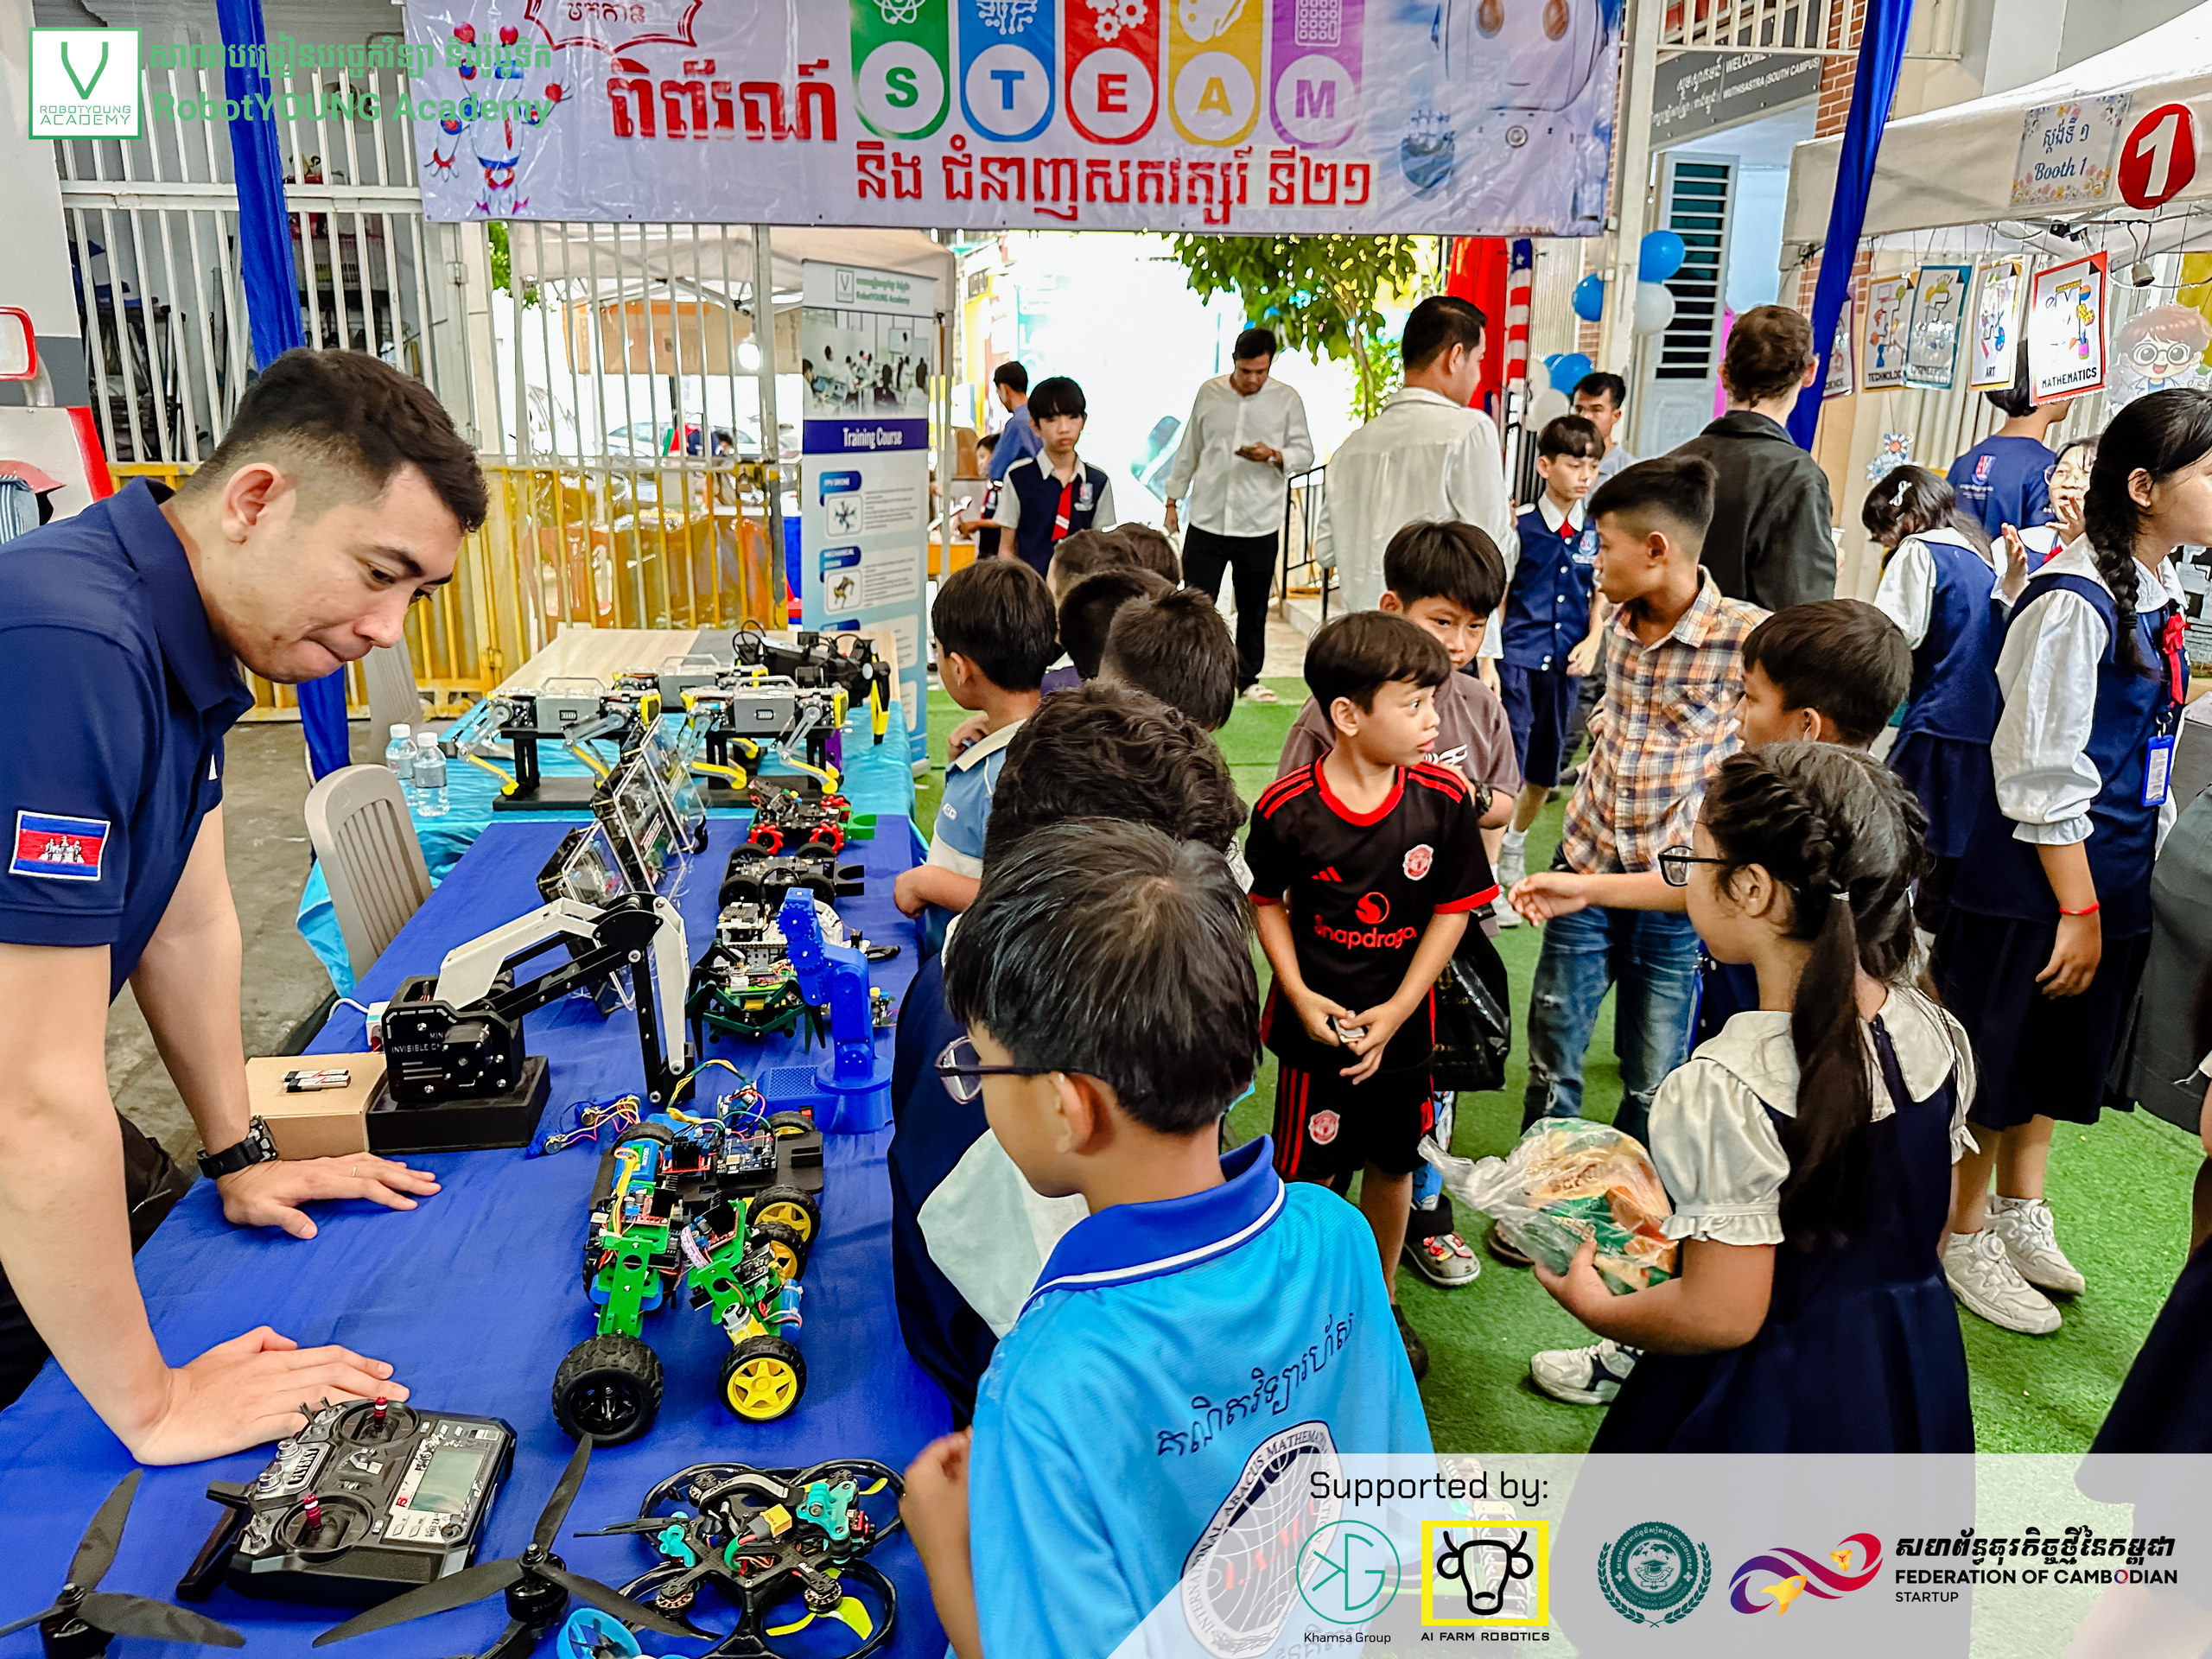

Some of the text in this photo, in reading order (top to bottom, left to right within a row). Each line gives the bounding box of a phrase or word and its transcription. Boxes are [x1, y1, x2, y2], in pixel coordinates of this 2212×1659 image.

[2136, 113, 2180, 198] 1
[857, 141, 923, 200] និង
[2034, 156, 2088, 181] Booth 1
[1985, 366, 1996, 378] ART
[2042, 366, 2097, 388] MATHEMATICS
[842, 427, 902, 449] Training Course
[1314, 914, 1417, 950] Snapdrago
[391, 1043, 429, 1053] INVISIBLE
[290, 1449, 319, 1482] FLYSKY
